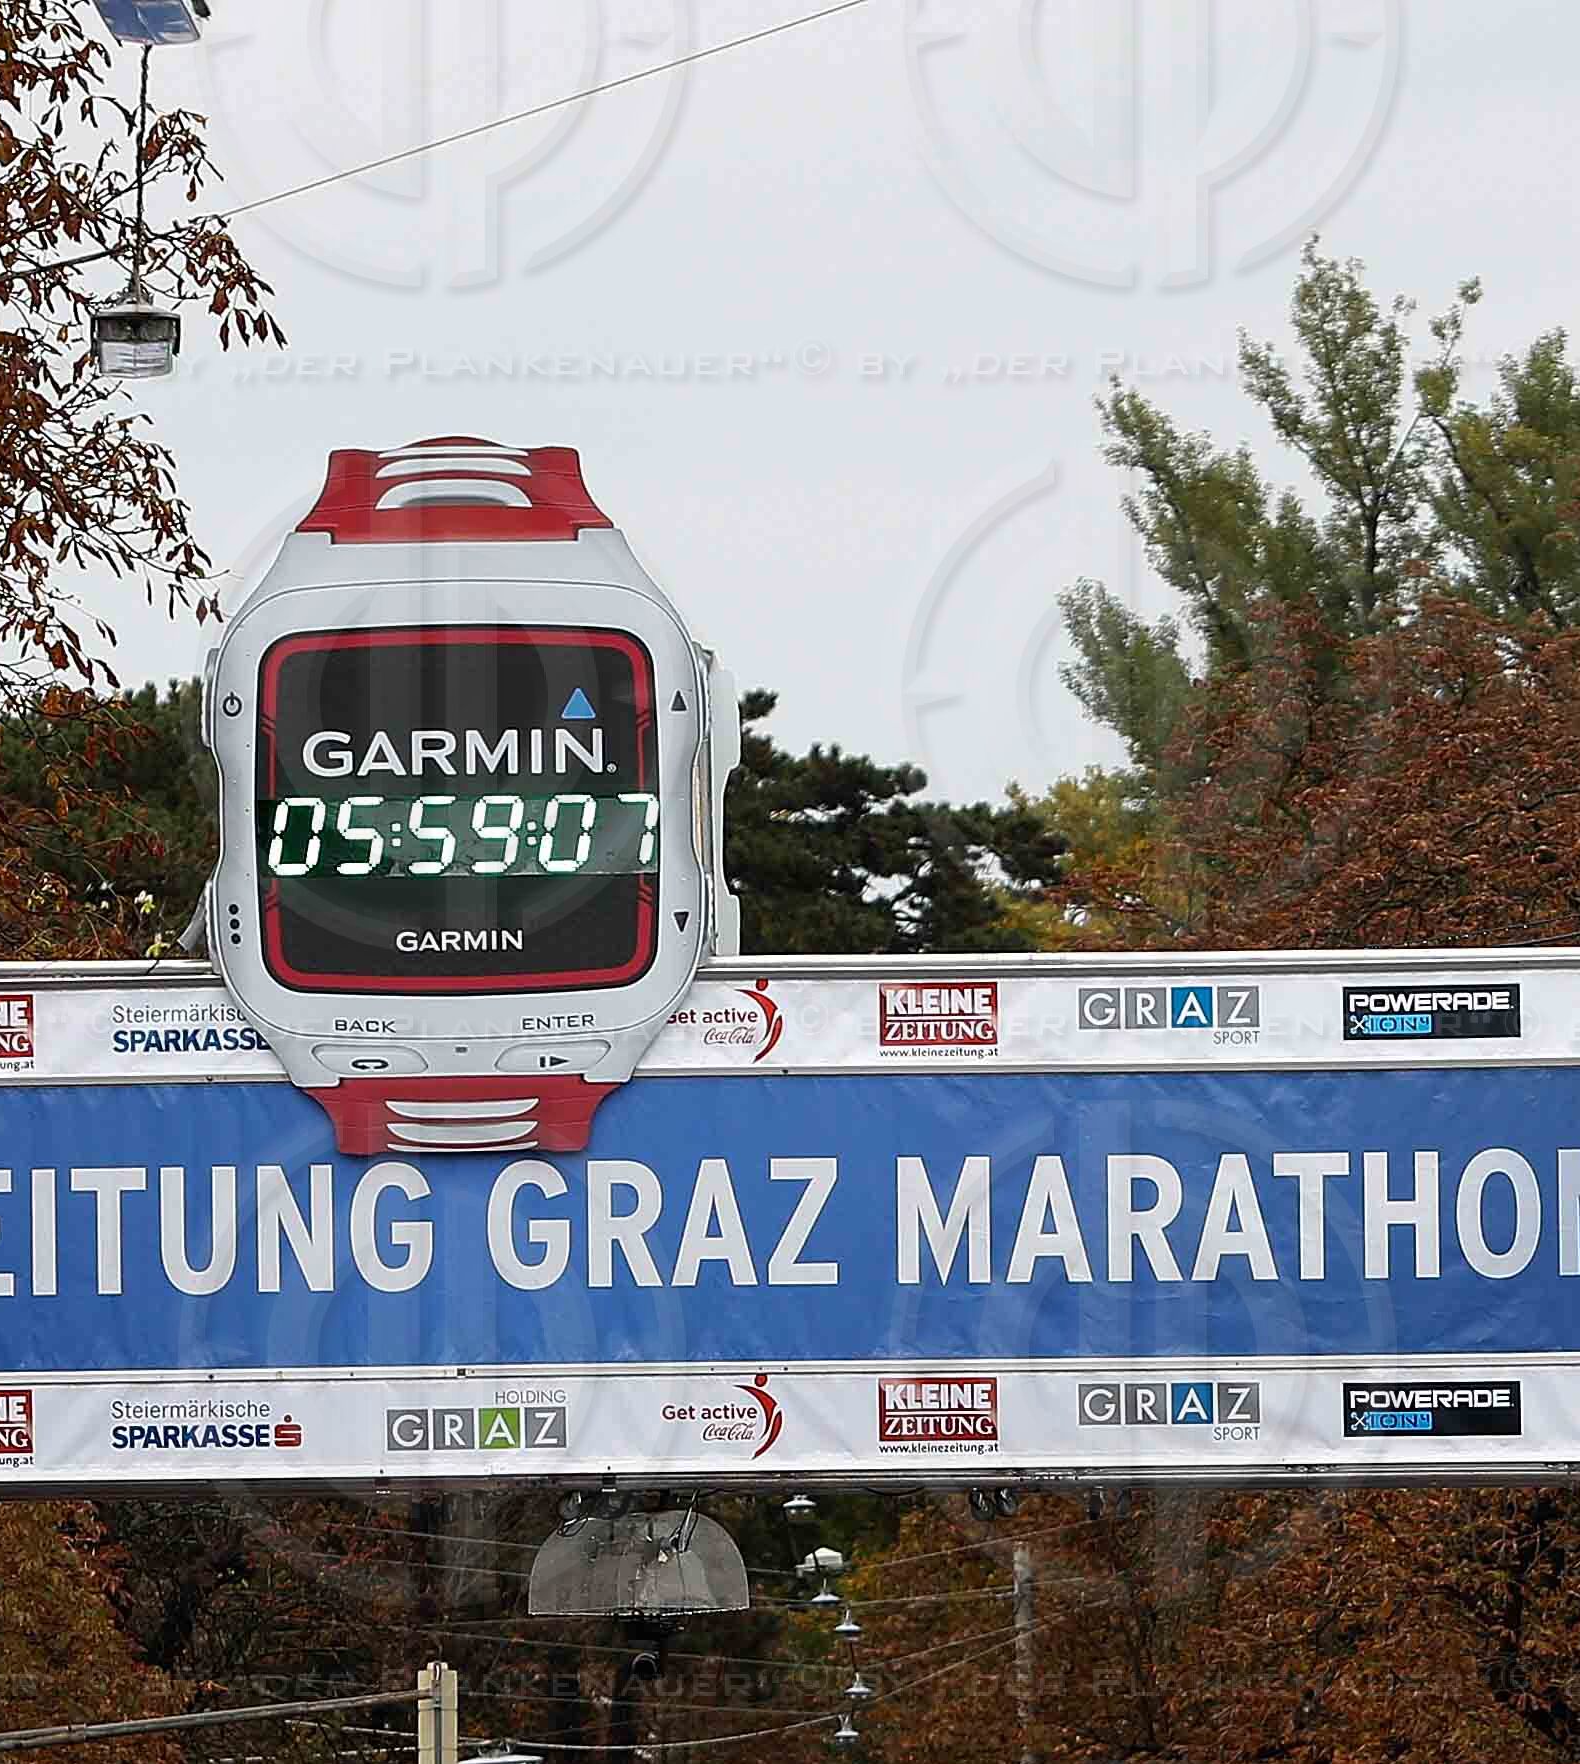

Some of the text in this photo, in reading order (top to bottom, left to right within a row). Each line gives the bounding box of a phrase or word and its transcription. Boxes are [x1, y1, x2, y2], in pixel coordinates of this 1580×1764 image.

[302, 727, 616, 778] GARMIN
[267, 793, 660, 876] 05:59:07
[395, 929, 524, 952] GARMIN
[883, 988, 991, 1016] KLEINE
[1082, 990, 1254, 1027] GRAZ
[1349, 991, 1515, 1013] POWERADE
[113, 1004, 245, 1024] Steiermärkisc
[521, 1013, 596, 1031] ENTER
[702, 1008, 758, 1024] active
[334, 1018, 396, 1033] BACK
[883, 1019, 996, 1042] ZEITUNG
[1213, 1030, 1261, 1045] SPORT
[879, 1047, 999, 1059] www.kleinezeitung.at
[487, 1154, 840, 1290] GRAZ
[495, 1389, 567, 1404] HOLDING
[884, 1382, 991, 1411] KLEINE
[1082, 1386, 1254, 1423] GRAZ
[1349, 1387, 1514, 1409] POWERADE
[111, 1400, 271, 1419] Steiermärkische
[662, 1404, 757, 1421] Get active
[111, 1424, 270, 1448] SPARKASSE
[389, 1410, 565, 1449] GRAZ
[883, 1415, 996, 1438] ZEITUNG
[1213, 1426, 1260, 1440] SPORT
[879, 1443, 999, 1455] www.kleinezeitung.at
